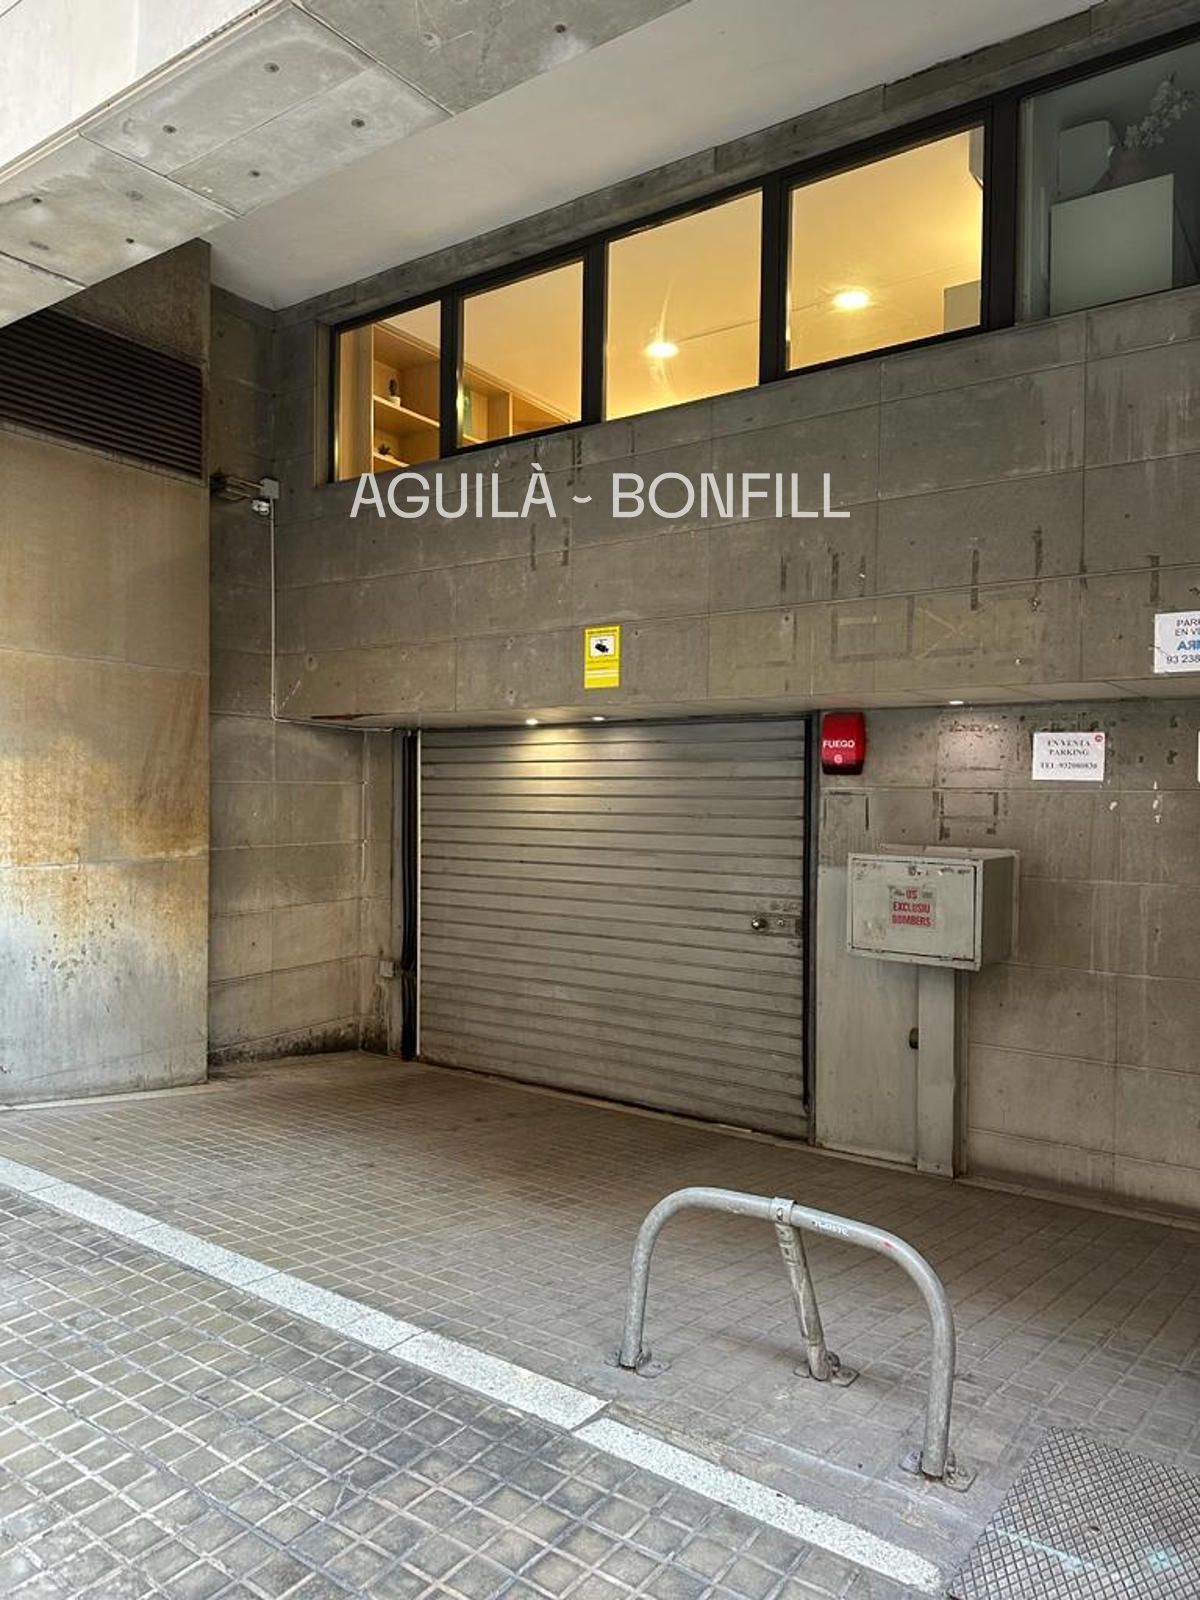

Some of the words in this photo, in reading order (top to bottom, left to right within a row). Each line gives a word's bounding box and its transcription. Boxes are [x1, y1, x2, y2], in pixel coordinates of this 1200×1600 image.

[1166, 655, 1179, 665] 93
[822, 739, 856, 749] FUEGO
[892, 914, 932, 927] BOMBERS
